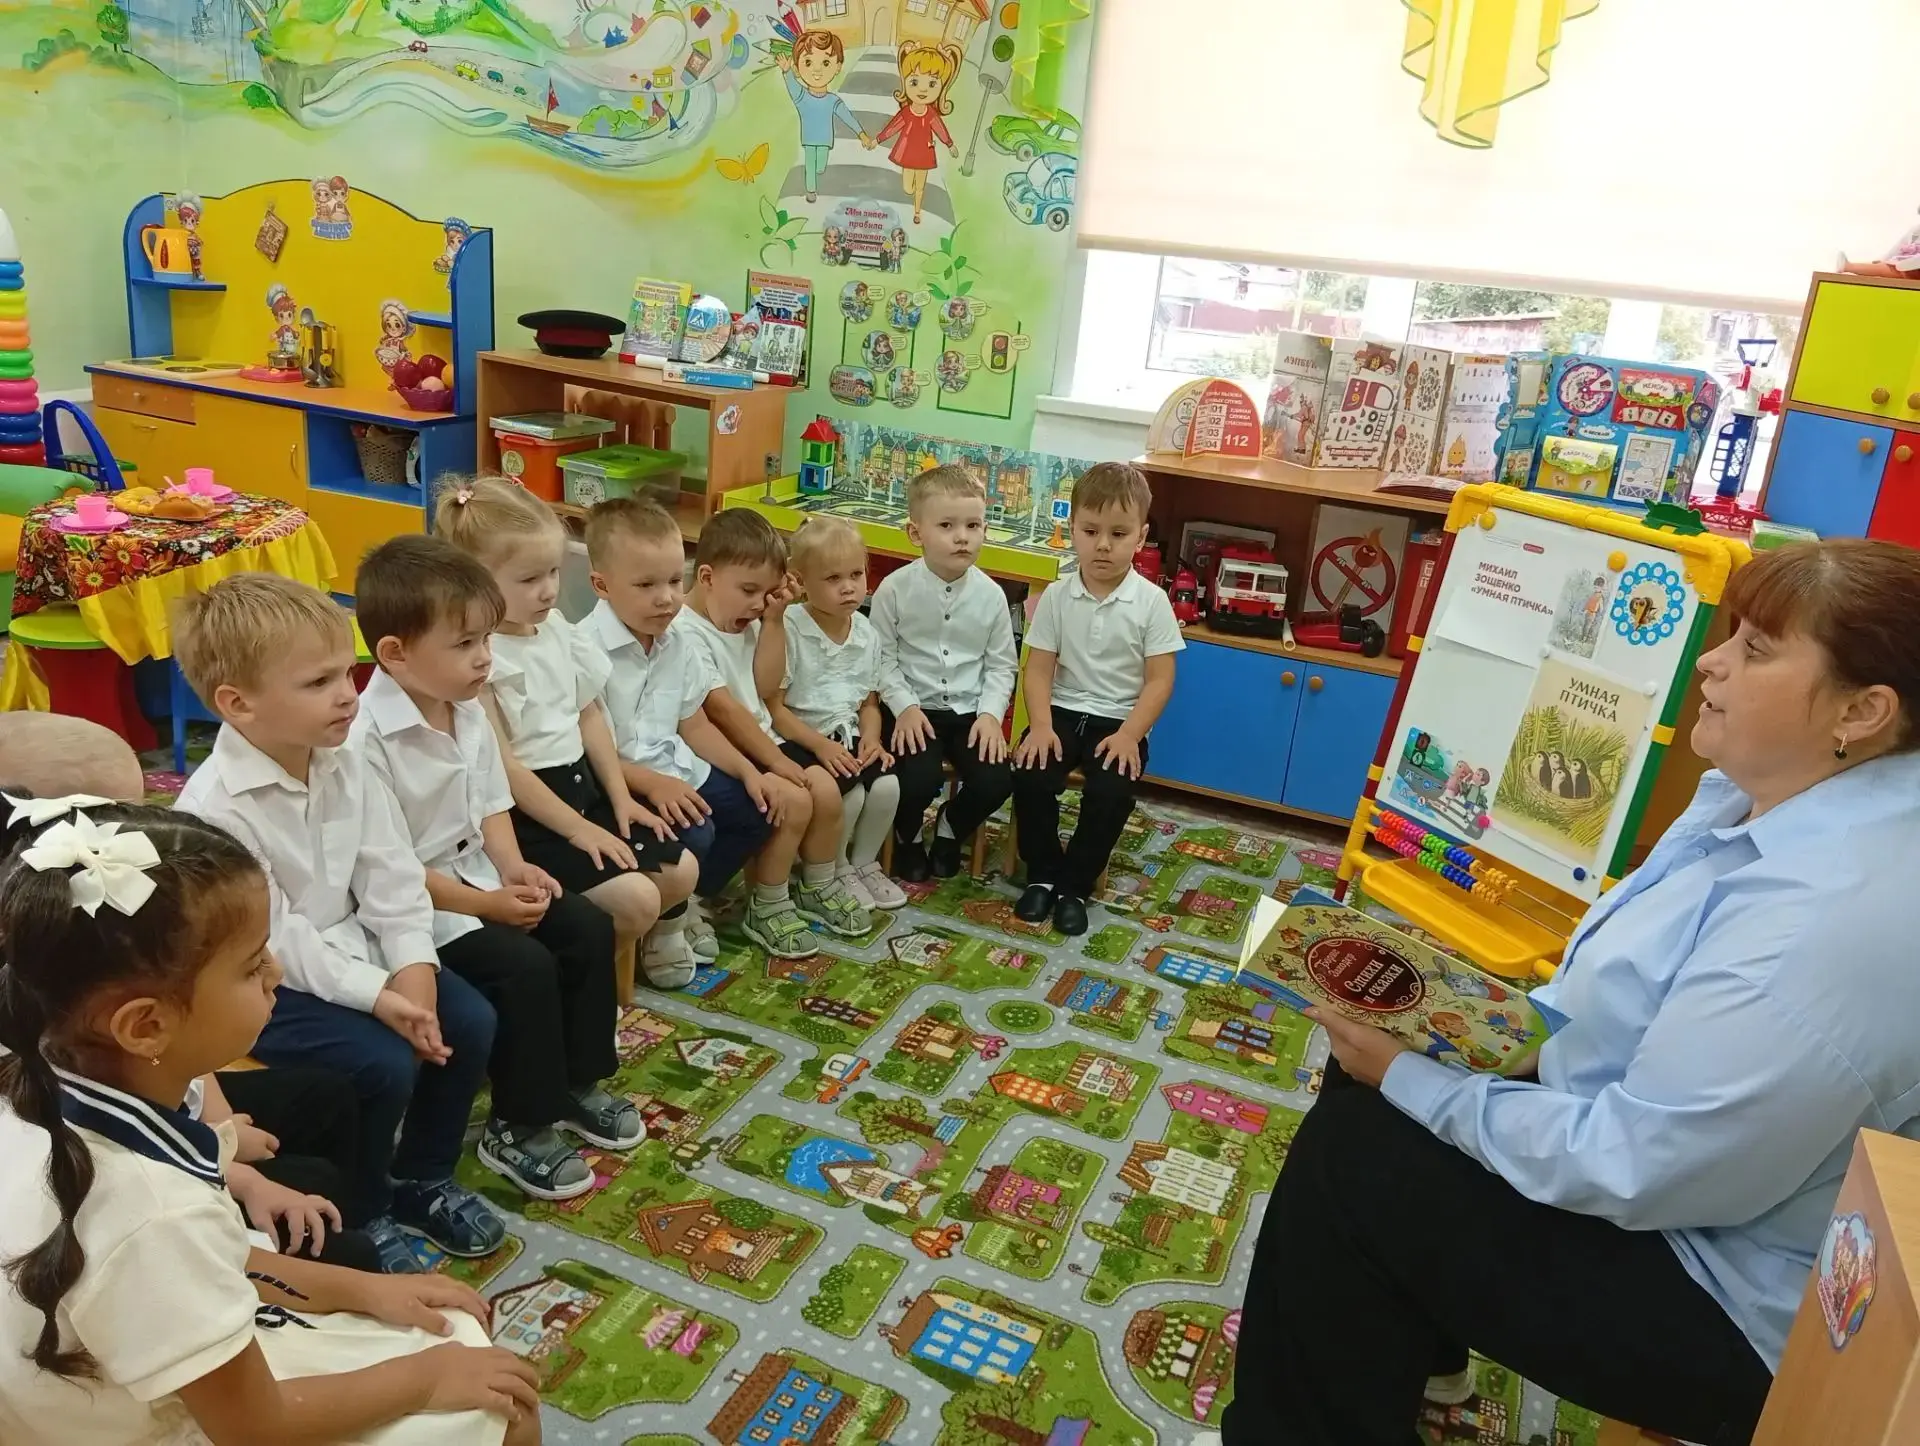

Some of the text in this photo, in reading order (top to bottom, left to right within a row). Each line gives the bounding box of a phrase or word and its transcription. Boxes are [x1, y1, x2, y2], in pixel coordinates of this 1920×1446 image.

[848, 219, 883, 231] правила
[863, 210, 889, 220] знаем
[844, 230, 888, 242] дорожного
[1224, 434, 1249, 448] 112
[1478, 561, 1518, 580] МИХАИЛ
[1474, 573, 1521, 593] ЗОЩЕНКО
[1471, 586, 1554, 616] «УМНАЯ ПТИЧКА»
[1568, 677, 1620, 707] УМНАЯ
[1559, 689, 1617, 722] ПТИЧКА
[1344, 959, 1385, 993] Стихи
[1363, 963, 1405, 1004] и сказки
